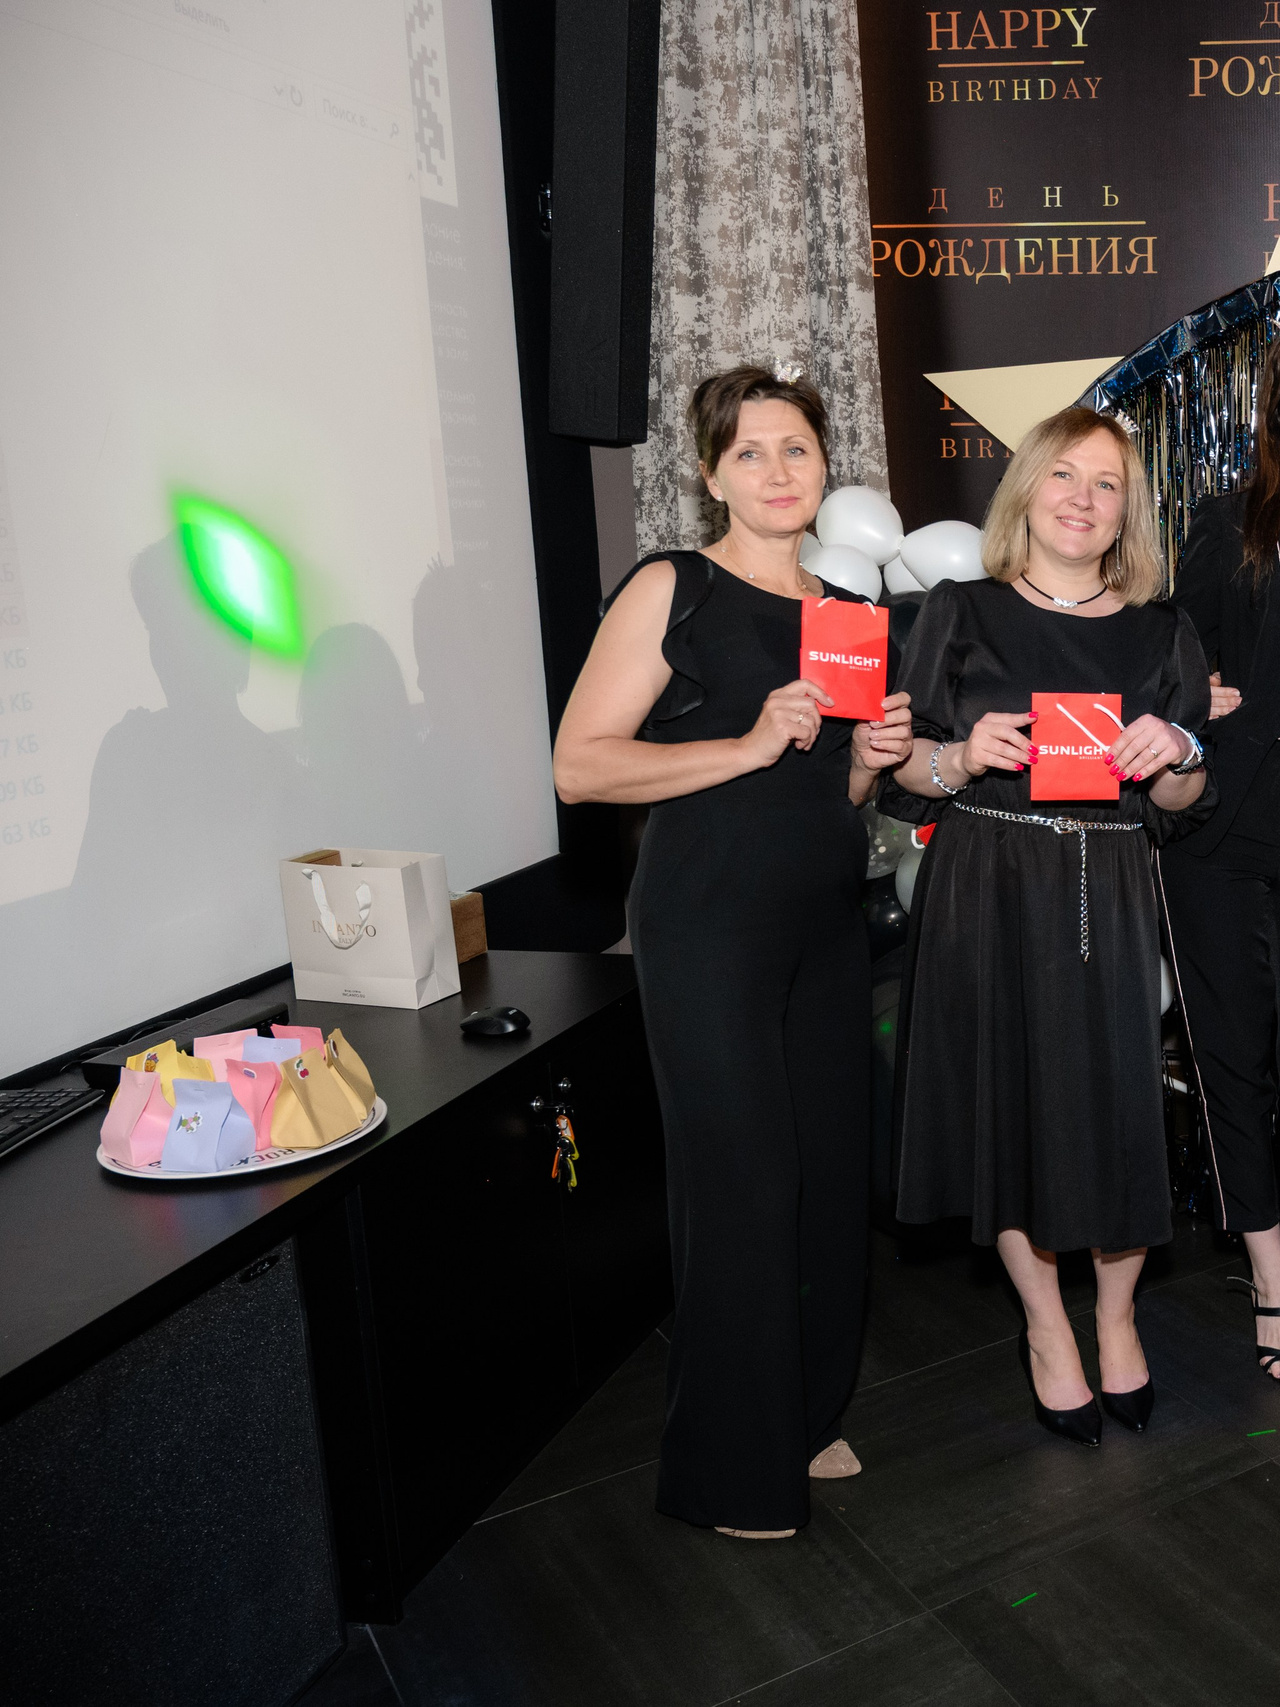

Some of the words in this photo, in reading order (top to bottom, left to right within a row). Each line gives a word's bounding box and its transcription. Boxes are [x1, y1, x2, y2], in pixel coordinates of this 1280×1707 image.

[926, 7, 1096, 51] HAPPY
[927, 77, 1102, 103] BIRTHDAY
[928, 185, 1119, 214] ДЕНЬ
[870, 236, 1158, 285] РОЖДЕНИЯ
[808, 650, 881, 668] SUNLIGHT
[1039, 744, 1111, 756] SUNLIGH
